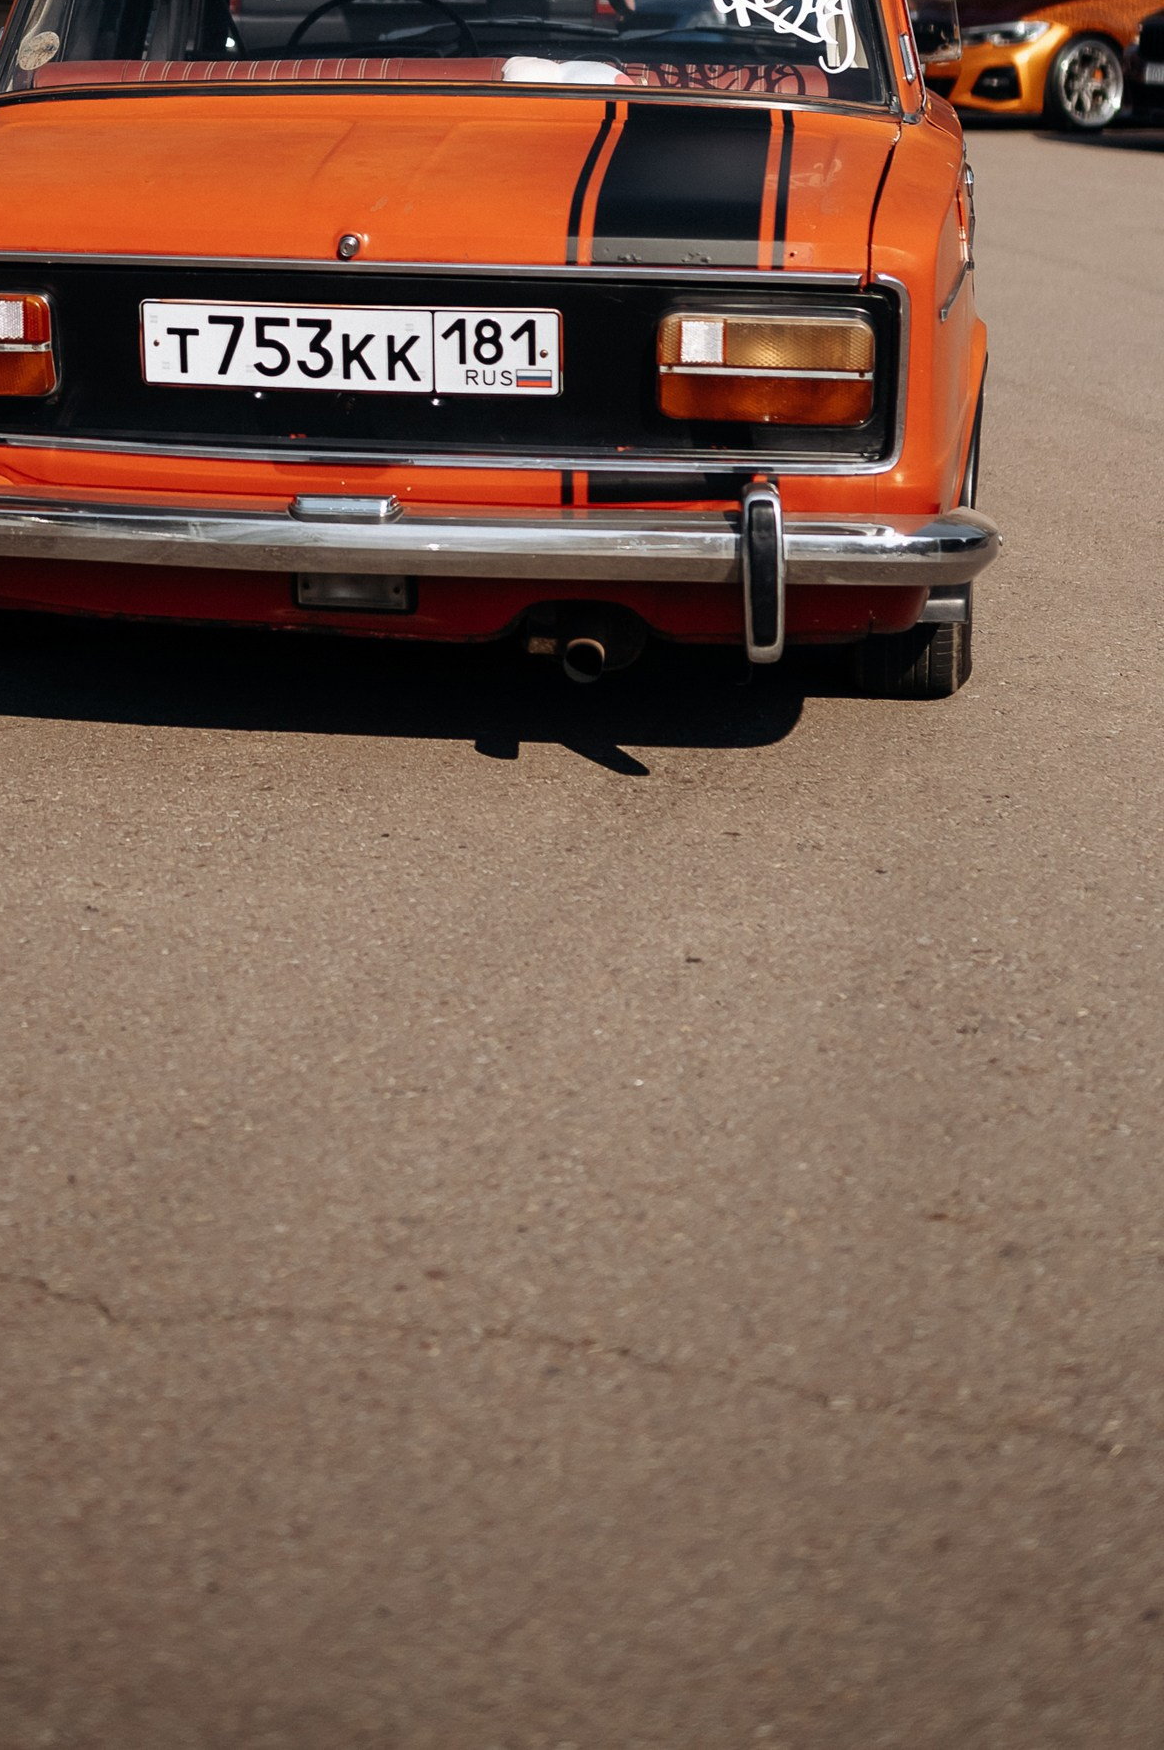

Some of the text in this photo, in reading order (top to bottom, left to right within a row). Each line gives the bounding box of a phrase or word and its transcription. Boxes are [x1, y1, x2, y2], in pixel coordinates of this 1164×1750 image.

[166, 314, 537, 382] Т753КК 181
[465, 369, 513, 386] RUS
